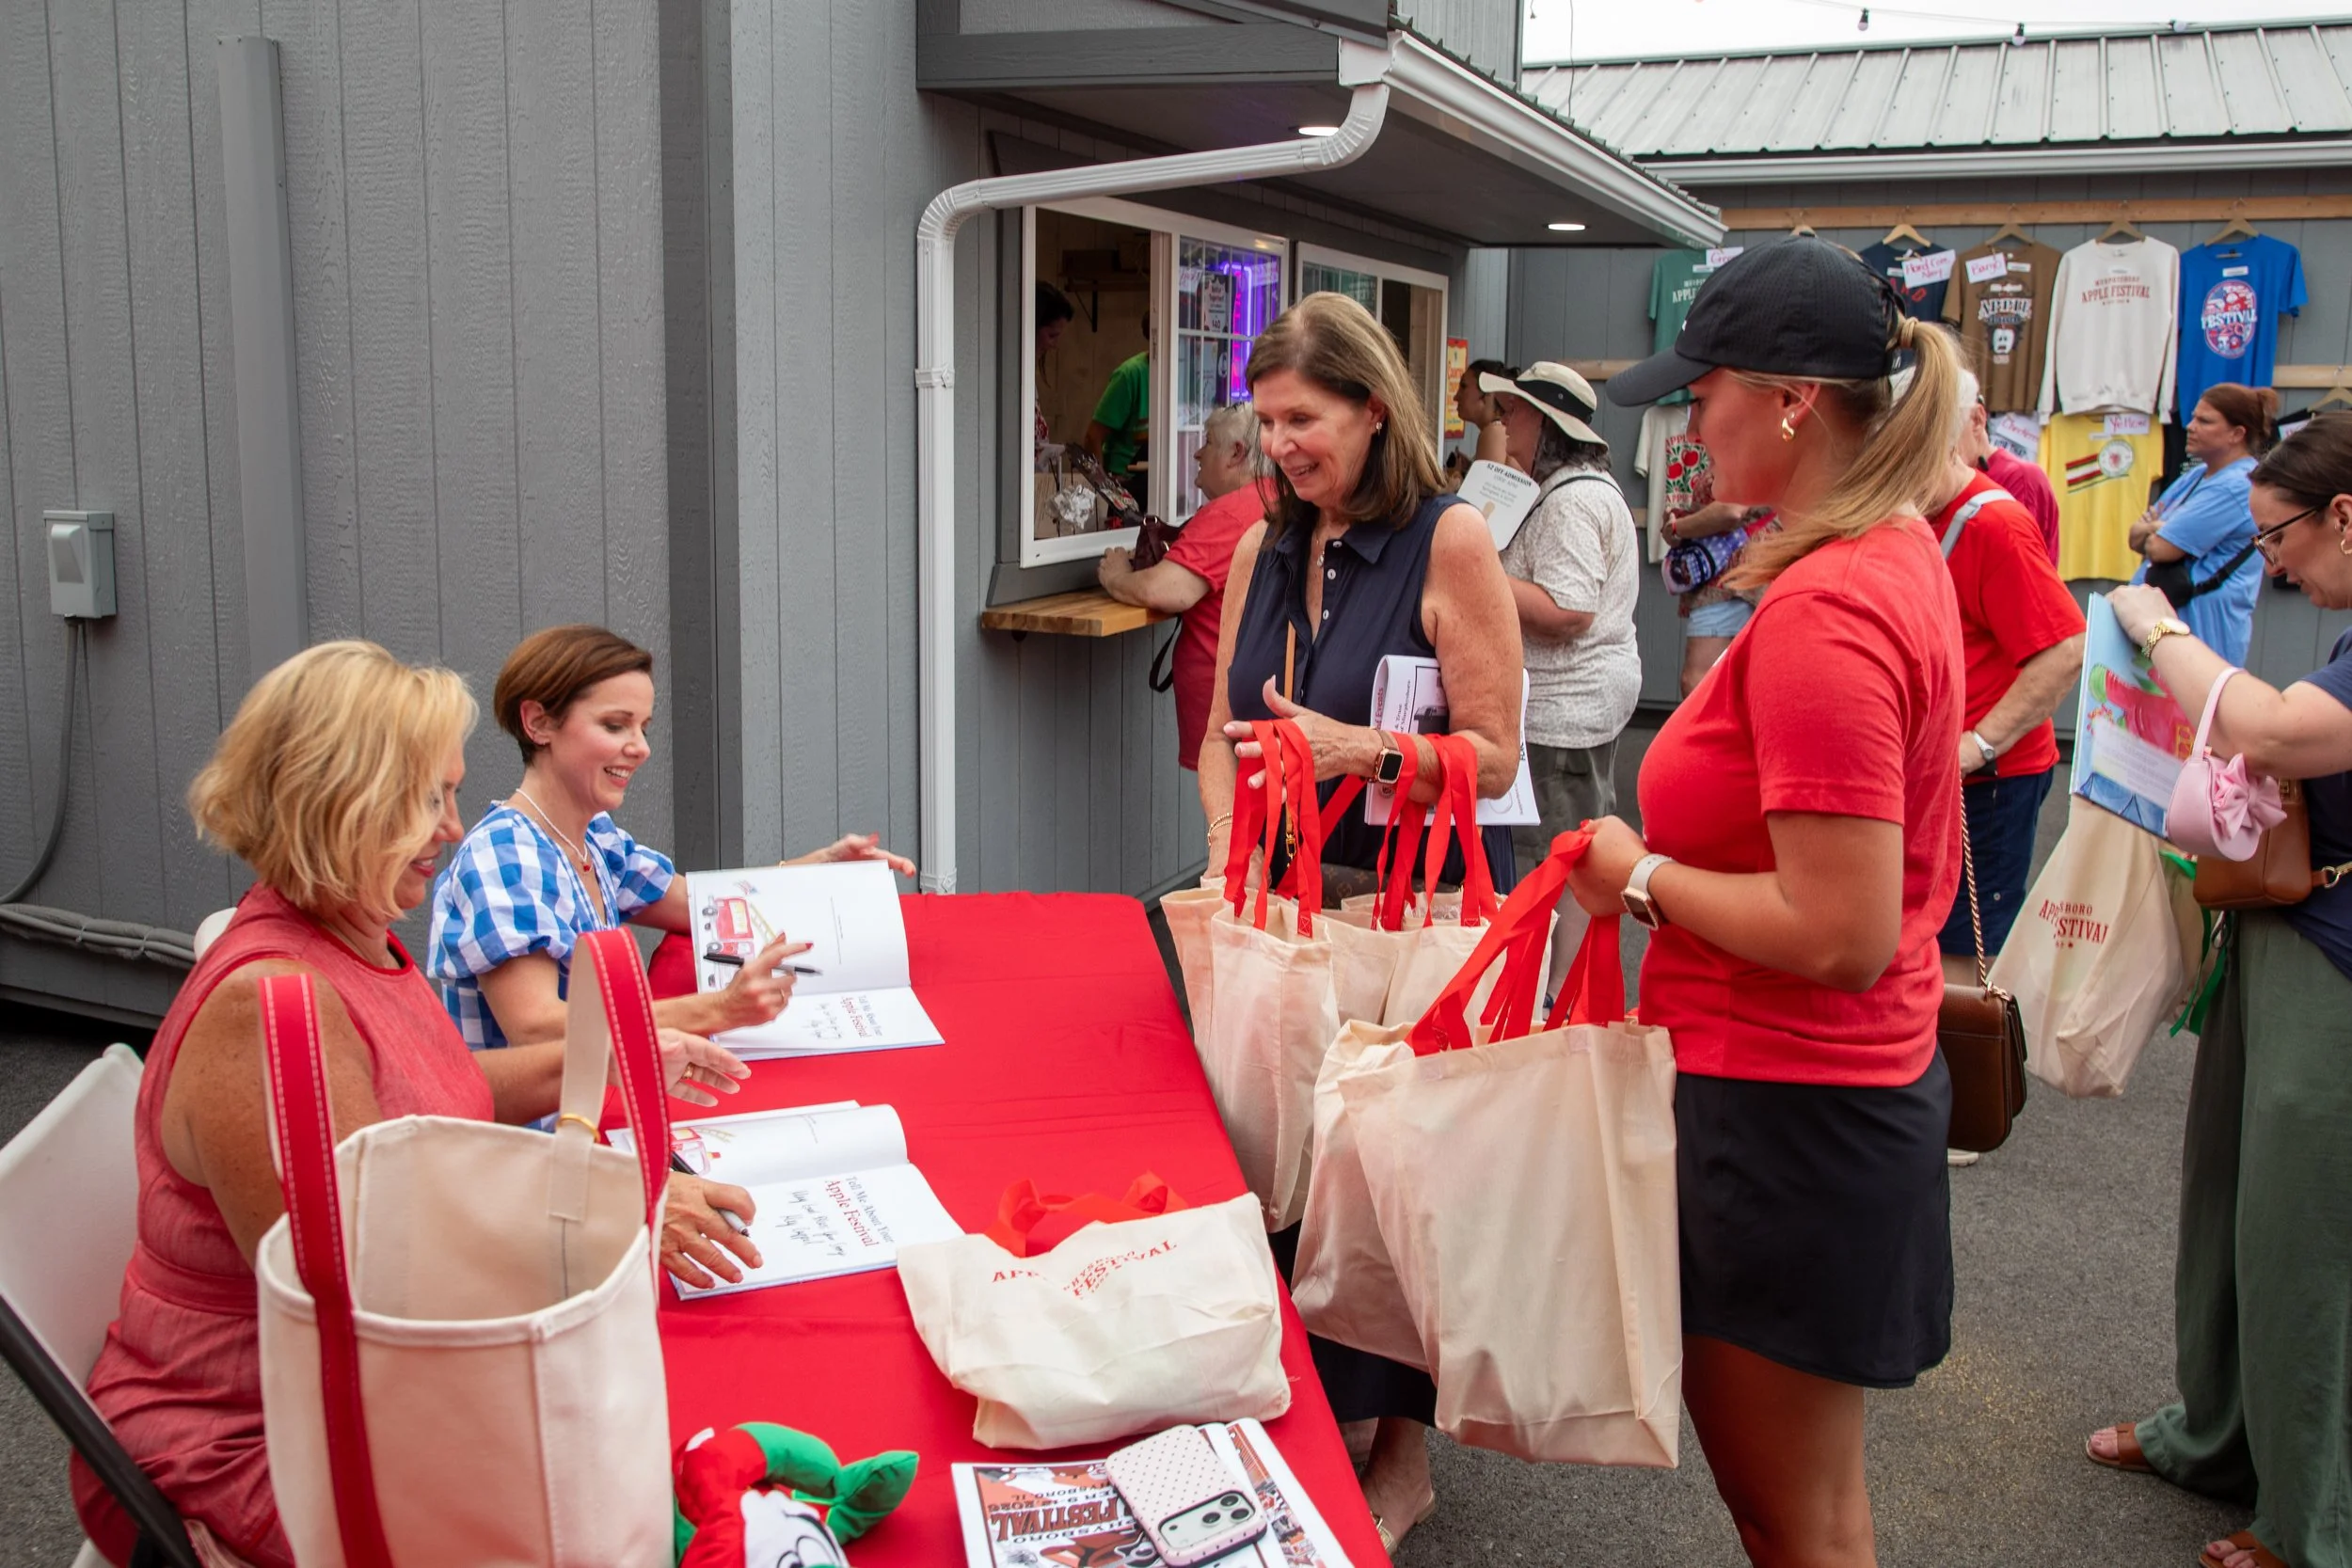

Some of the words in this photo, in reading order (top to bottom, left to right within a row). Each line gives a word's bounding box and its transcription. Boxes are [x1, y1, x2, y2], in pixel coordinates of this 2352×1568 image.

[2081, 287, 2108, 303] APPLE
[2111, 284, 2151, 299] FESTIVAL
[825, 1180, 851, 1209] Apple
[843, 1210, 880, 1247] Festival
[846, 1176, 862, 1190] Tell
[856, 1190, 868, 1203] Me
[864, 1205, 882, 1227] About
[877, 1226, 895, 1243] Your
[991, 1497, 1119, 1543] FESTIVAL
[1013, 1517, 1136, 1544] PHYSBORO
